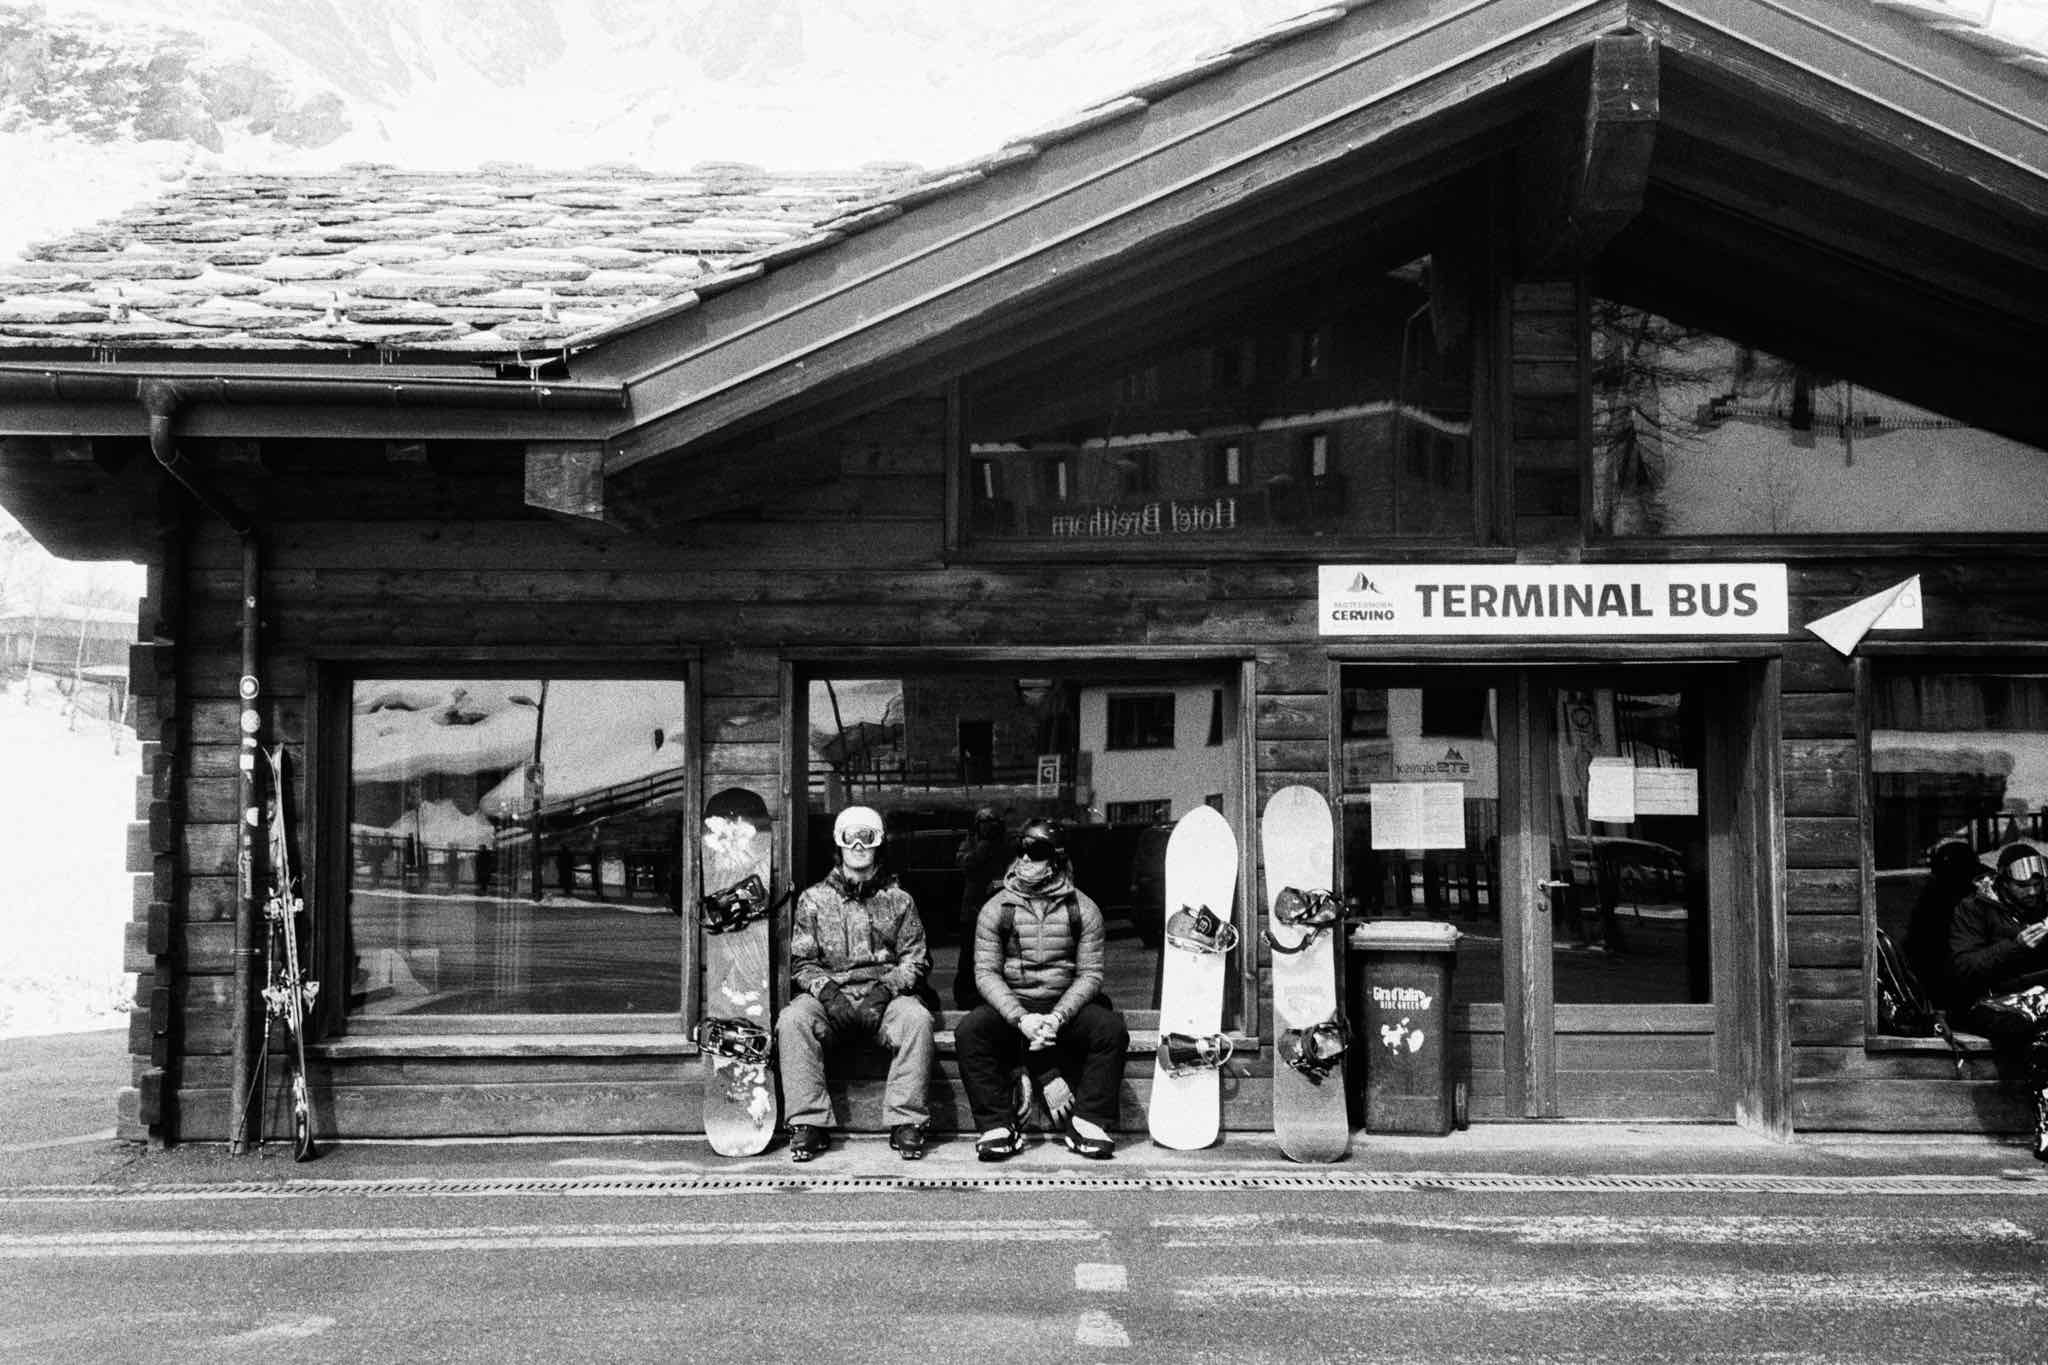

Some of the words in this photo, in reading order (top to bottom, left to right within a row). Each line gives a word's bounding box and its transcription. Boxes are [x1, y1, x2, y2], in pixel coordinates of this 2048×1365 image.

[1415, 583, 1654, 618] TERMINAL
[1668, 582, 1759, 618] BUS
[1332, 610, 1395, 621] CERVINO
